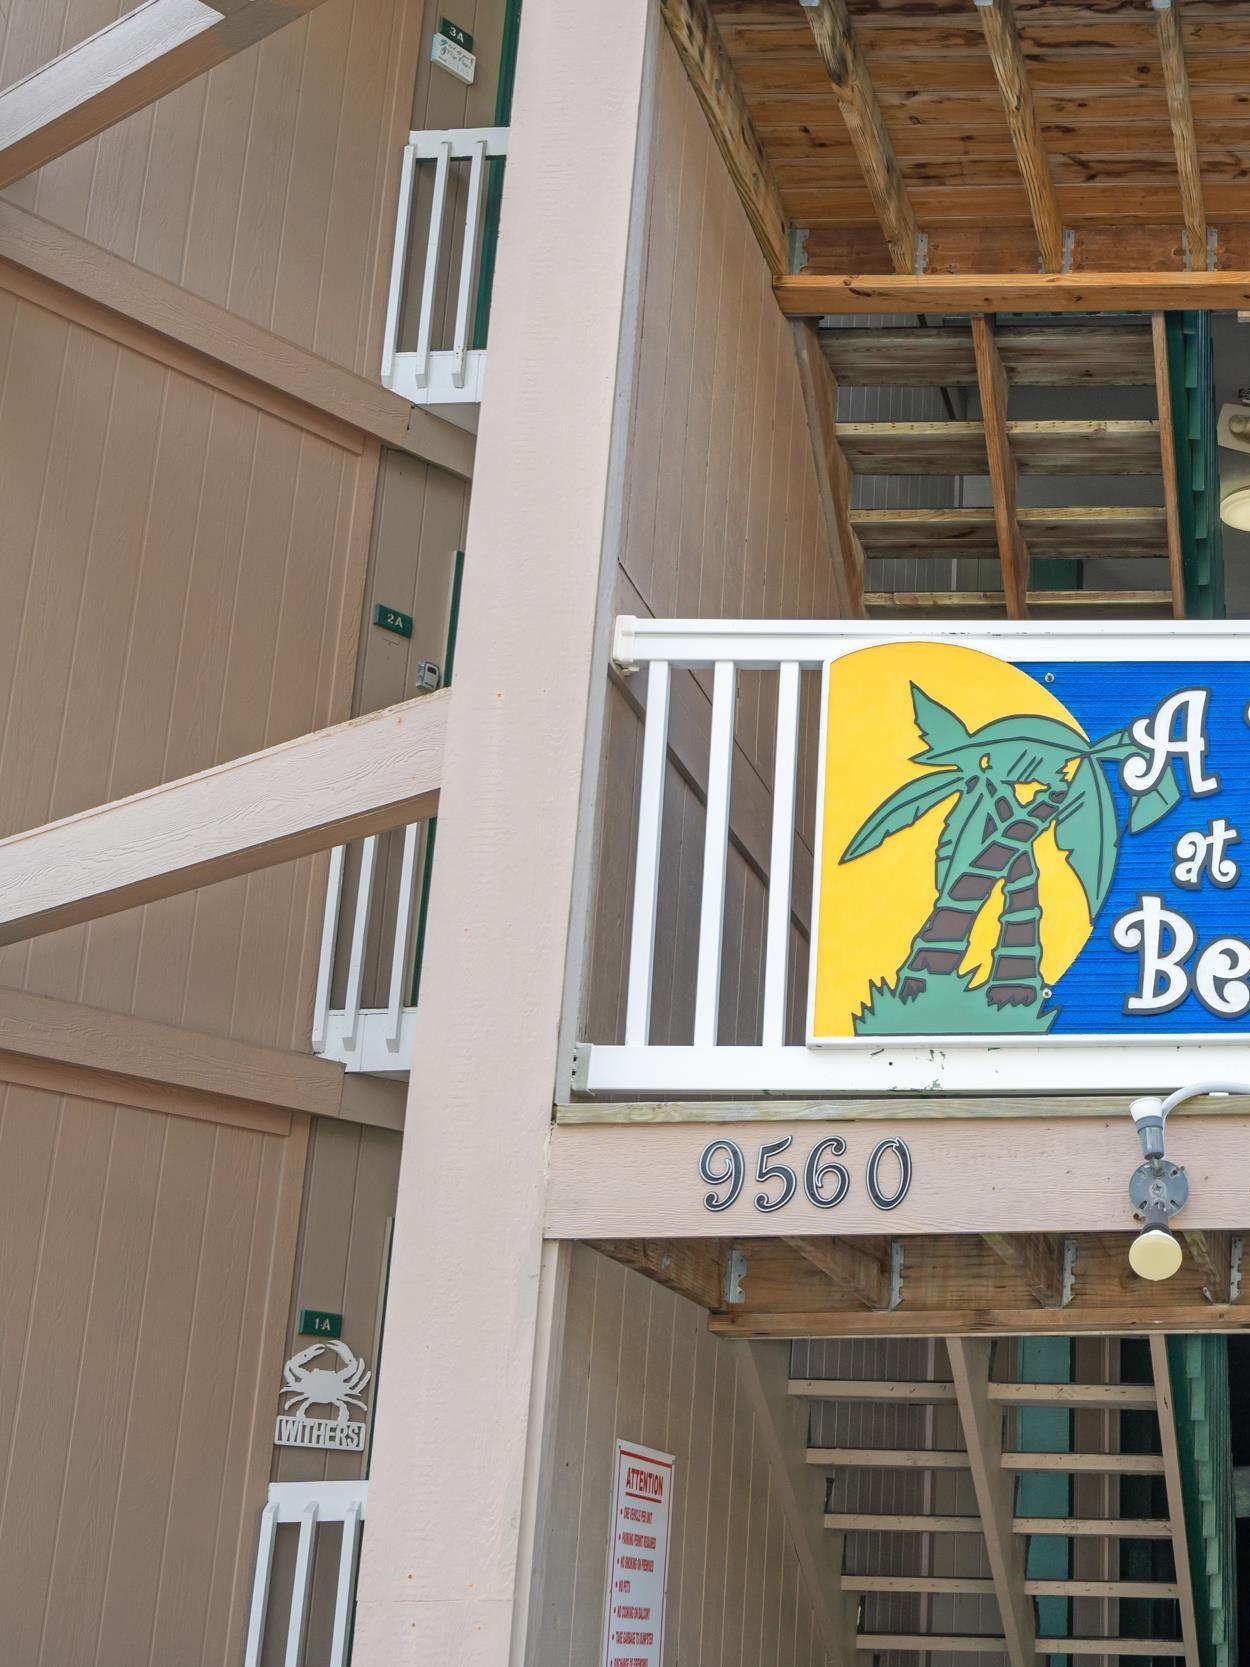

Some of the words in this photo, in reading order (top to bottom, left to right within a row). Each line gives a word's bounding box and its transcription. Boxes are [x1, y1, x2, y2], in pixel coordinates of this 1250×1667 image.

[449, 26, 464, 43] 3A
[386, 613, 403, 629] 2A
[1120, 688, 1221, 796] A
[1173, 818, 1240, 887] at
[699, 1135, 913, 1212] 9560
[280, 1419, 359, 1447] WITHERS
[625, 1467, 664, 1497] ATTENTION
